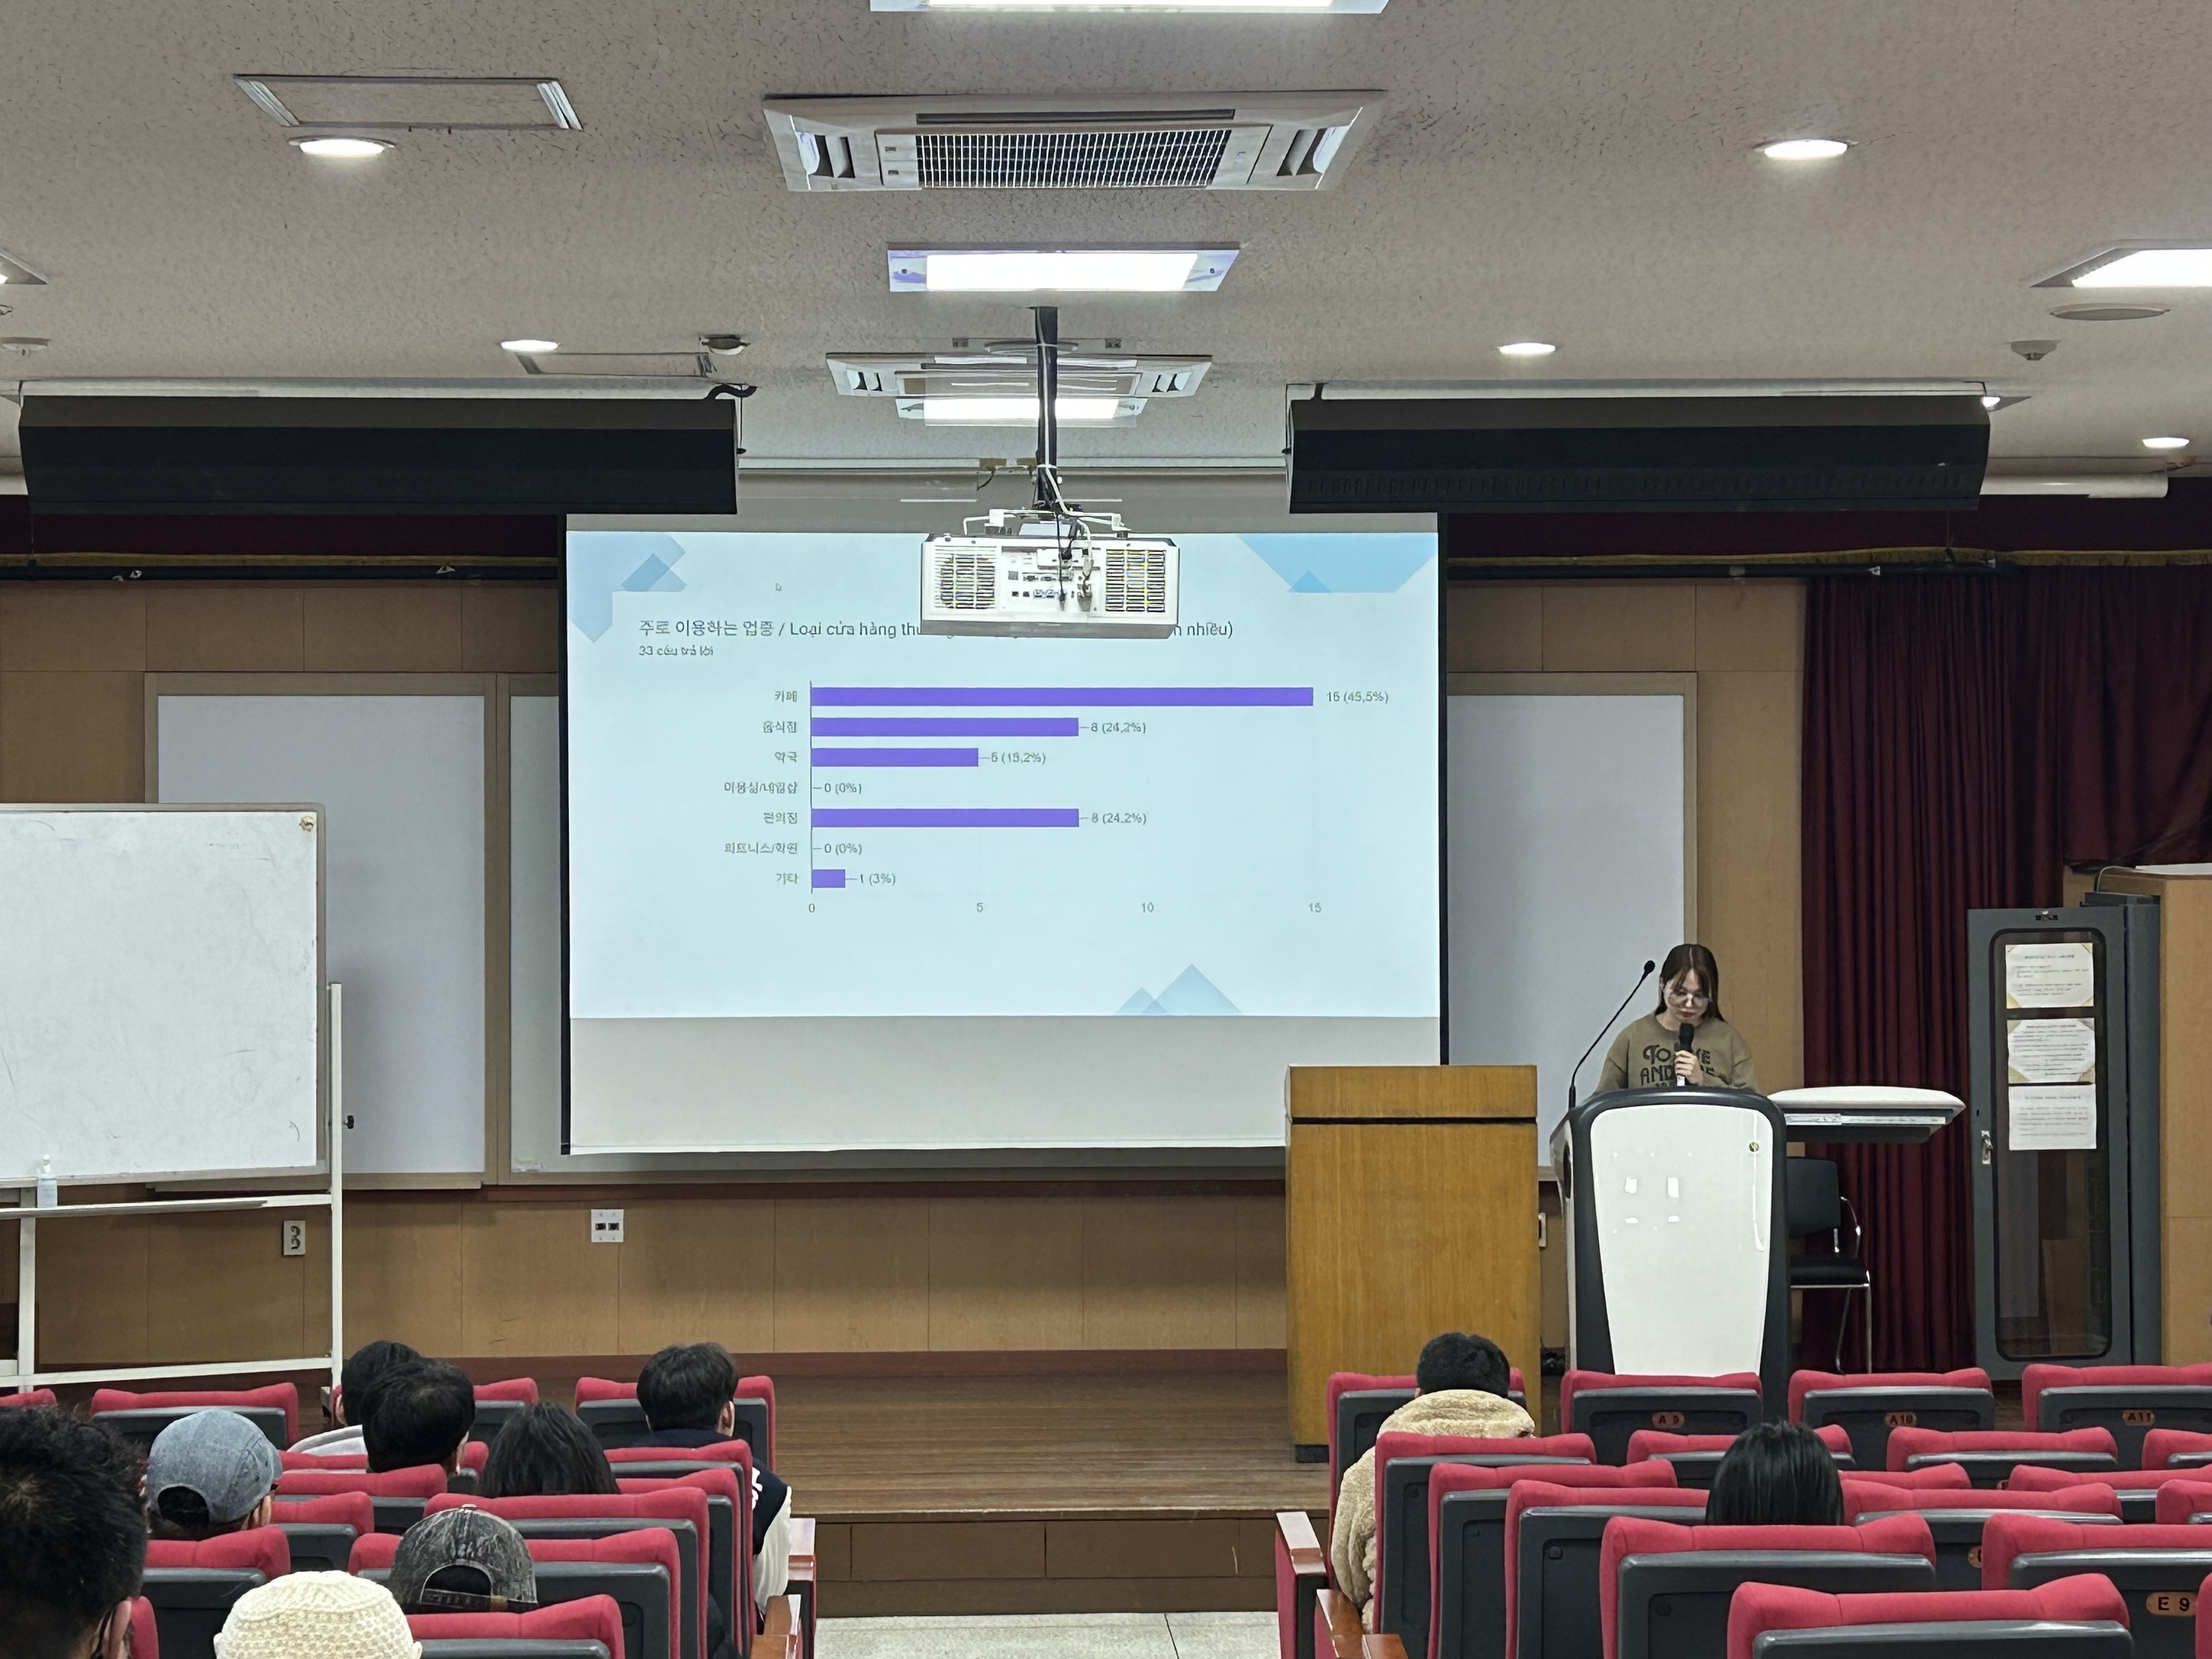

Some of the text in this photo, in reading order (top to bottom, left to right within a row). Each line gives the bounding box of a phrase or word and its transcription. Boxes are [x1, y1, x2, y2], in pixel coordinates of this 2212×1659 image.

[639, 620, 671, 636] 주로
[675, 619, 738, 637] 이용하는
[742, 620, 774, 636] 업종
[778, 622, 786, 637] /
[790, 622, 822, 638] Loại
[859, 621, 896, 639] hàng
[639, 645, 653, 656] 33
[774, 690, 798, 703] 카페
[1327, 691, 1340, 702] 15
[763, 720, 797, 734] 음식점
[1091, 722, 1098, 732] 8
[774, 751, 798, 764] 약국
[991, 752, 998, 763] 5
[824, 782, 862, 795] 0 (0%)
[763, 811, 798, 825] 편의점
[1091, 812, 1099, 823] 8
[824, 843, 862, 856] 0 (0%)
[775, 872, 799, 885] 기타
[860, 873, 896, 886] 1 (3%)
[808, 902, 1322, 913] 0 5 10 15
[2158, 1596, 2190, 1612] E 9
